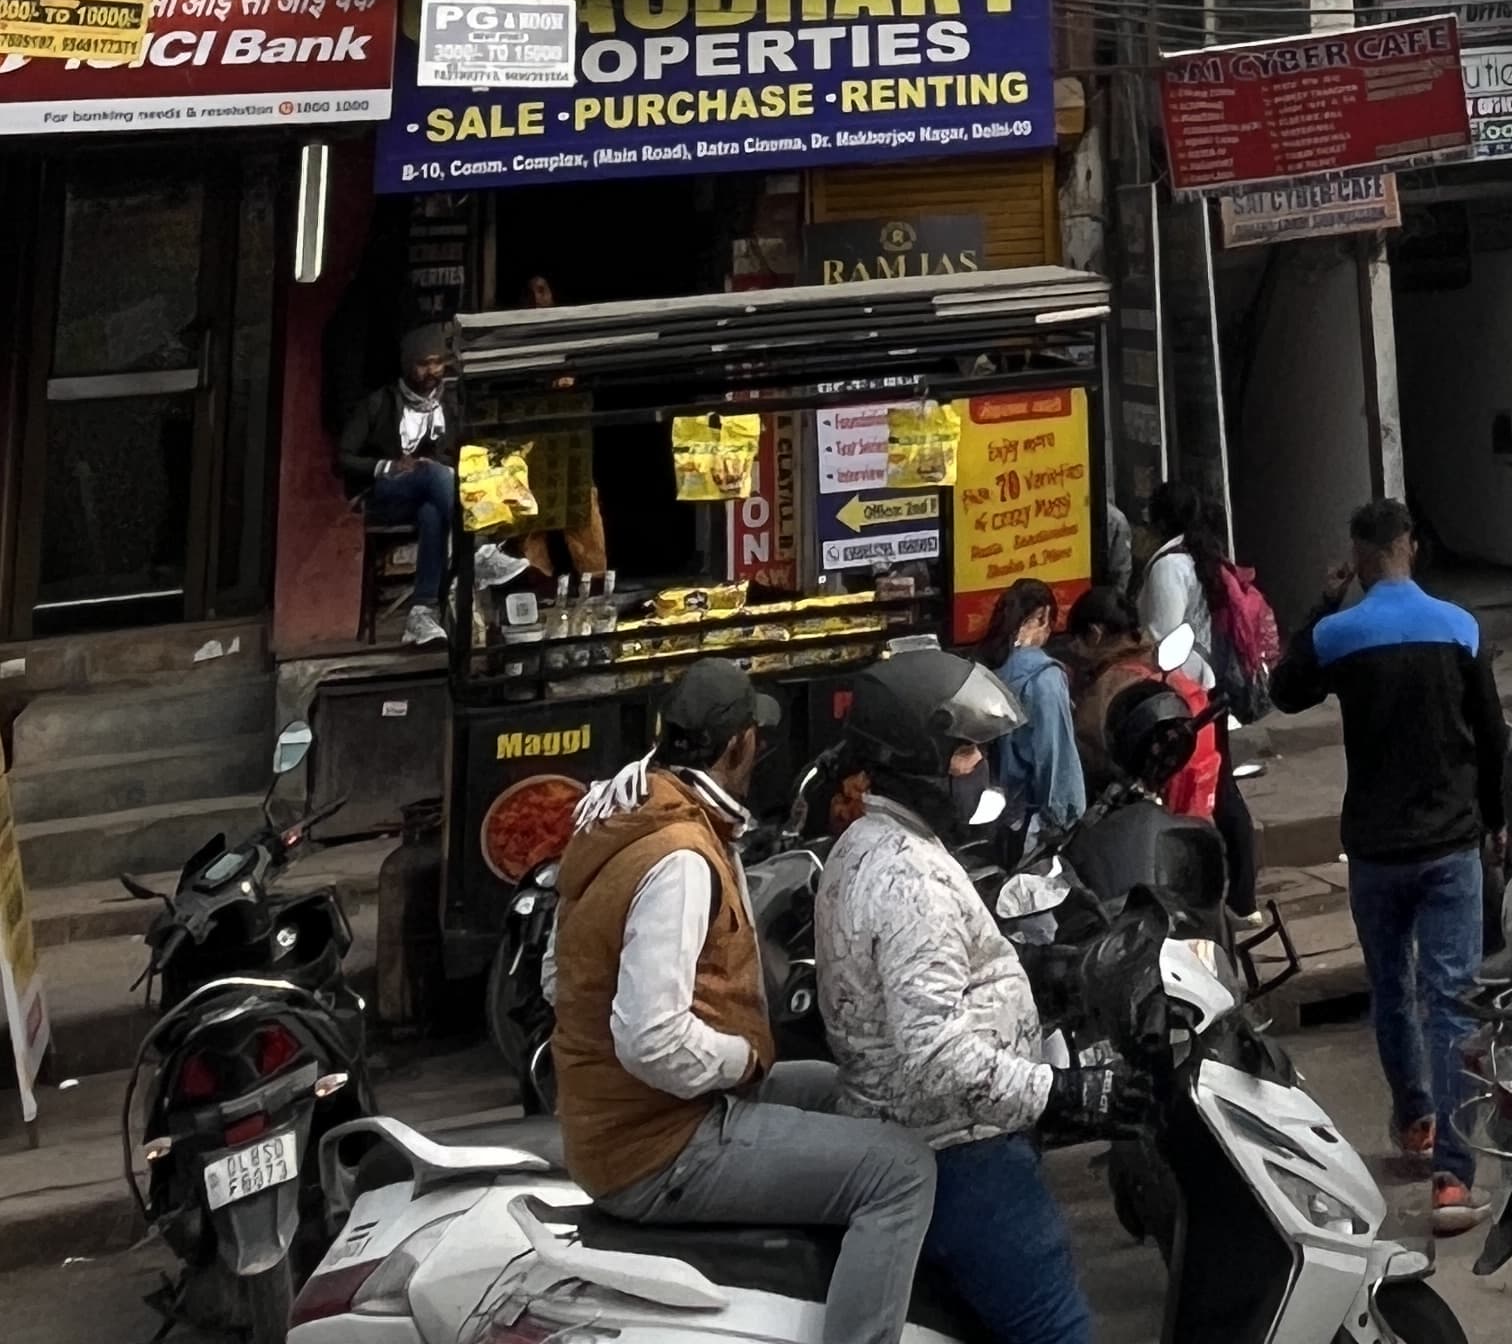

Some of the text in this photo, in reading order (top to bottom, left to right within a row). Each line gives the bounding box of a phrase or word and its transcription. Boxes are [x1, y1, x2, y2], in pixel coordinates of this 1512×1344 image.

[45, 8, 70, 23] TO
[435, 5, 499, 30] PG
[221, 26, 372, 65] Bank
[582, 21, 971, 83] OPERTIES
[1229, 41, 1348, 81] CYBER
[1354, 26, 1450, 61] CAFE
[73, 108, 133, 122] banking
[427, 72, 1029, 143] SALE PURCHASE RENTING
[450, 160, 507, 177] Comm.
[513, 152, 588, 172] Complex,
[811, 133, 832, 148] Dr.
[920, 125, 969, 143] Nagar,
[822, 248, 979, 285] RAM IAS
[496, 725, 591, 761] Maggi
